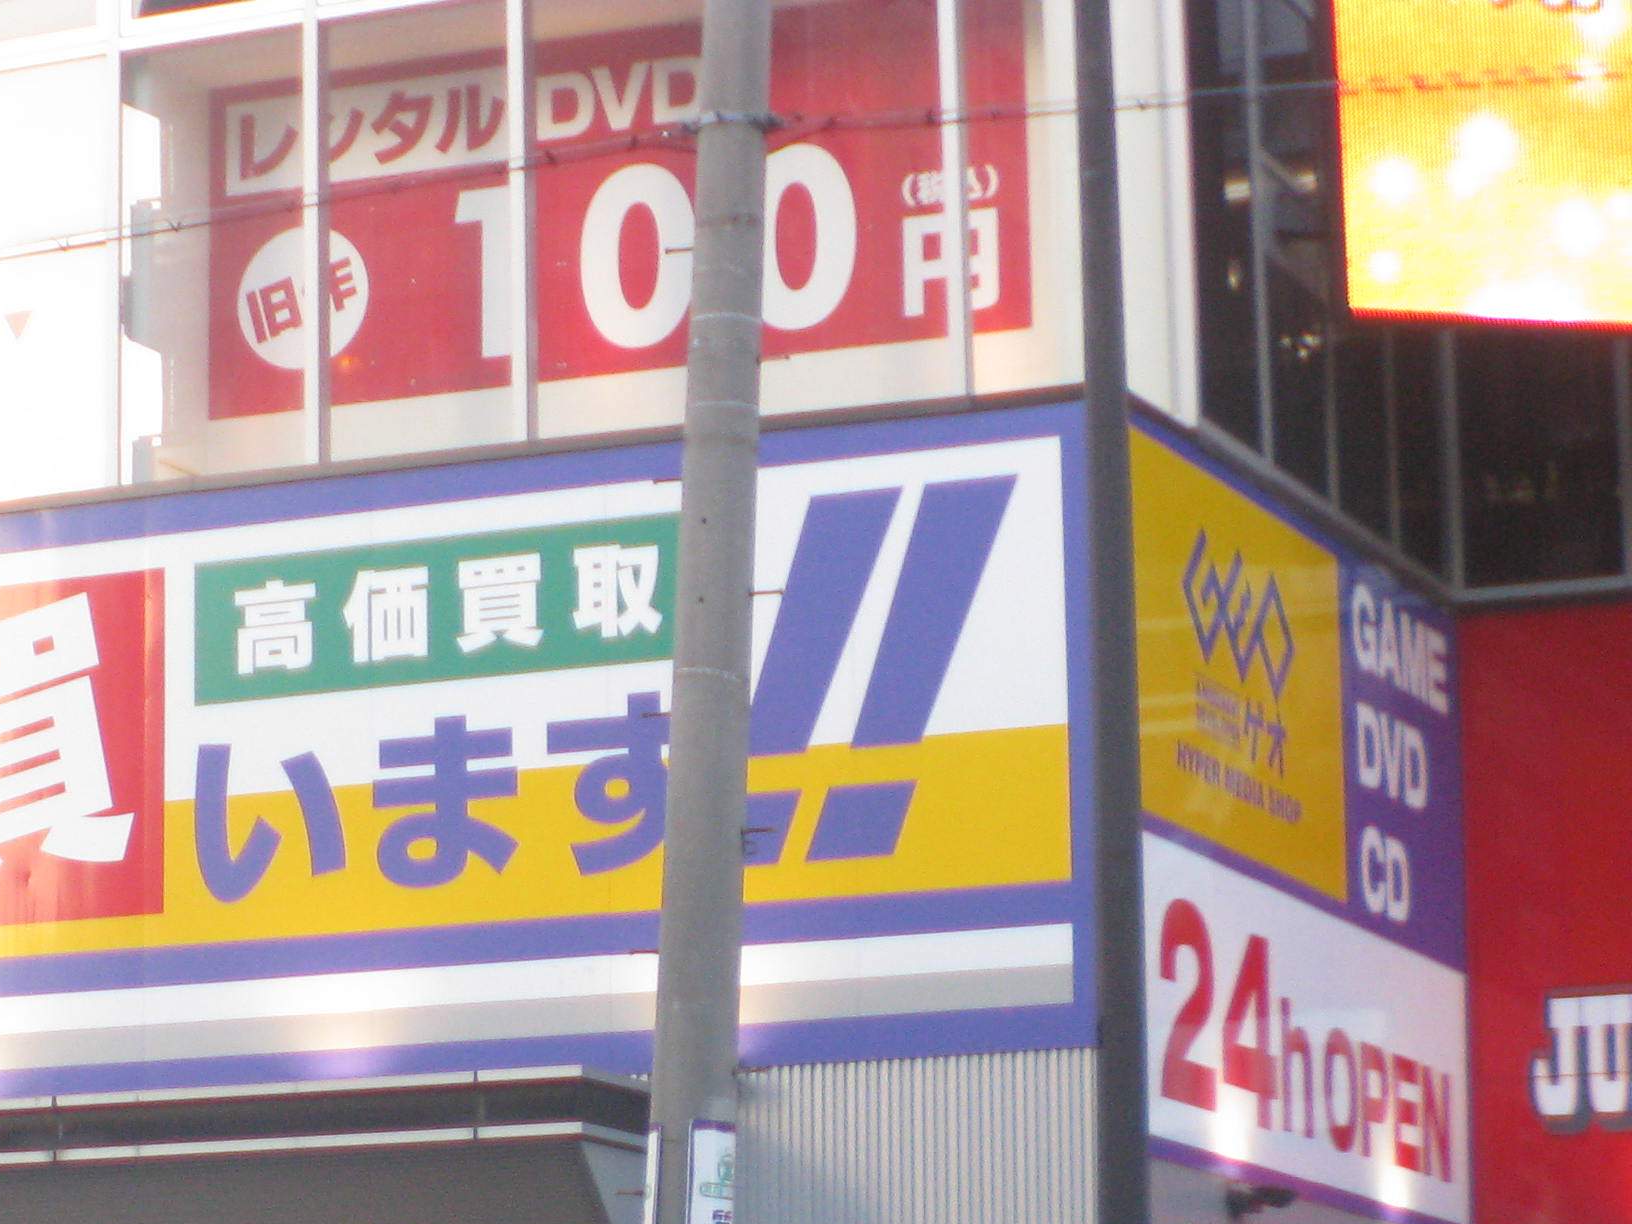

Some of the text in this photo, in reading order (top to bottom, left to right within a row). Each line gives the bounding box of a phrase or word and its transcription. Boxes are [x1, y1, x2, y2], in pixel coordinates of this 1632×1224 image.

[235, 542, 665, 675] 高価買取
[1182, 525, 1295, 700] GEO
[1352, 583, 1449, 715] GAME
[1357, 701, 1429, 810] DVD
[1361, 826, 1411, 923] CD
